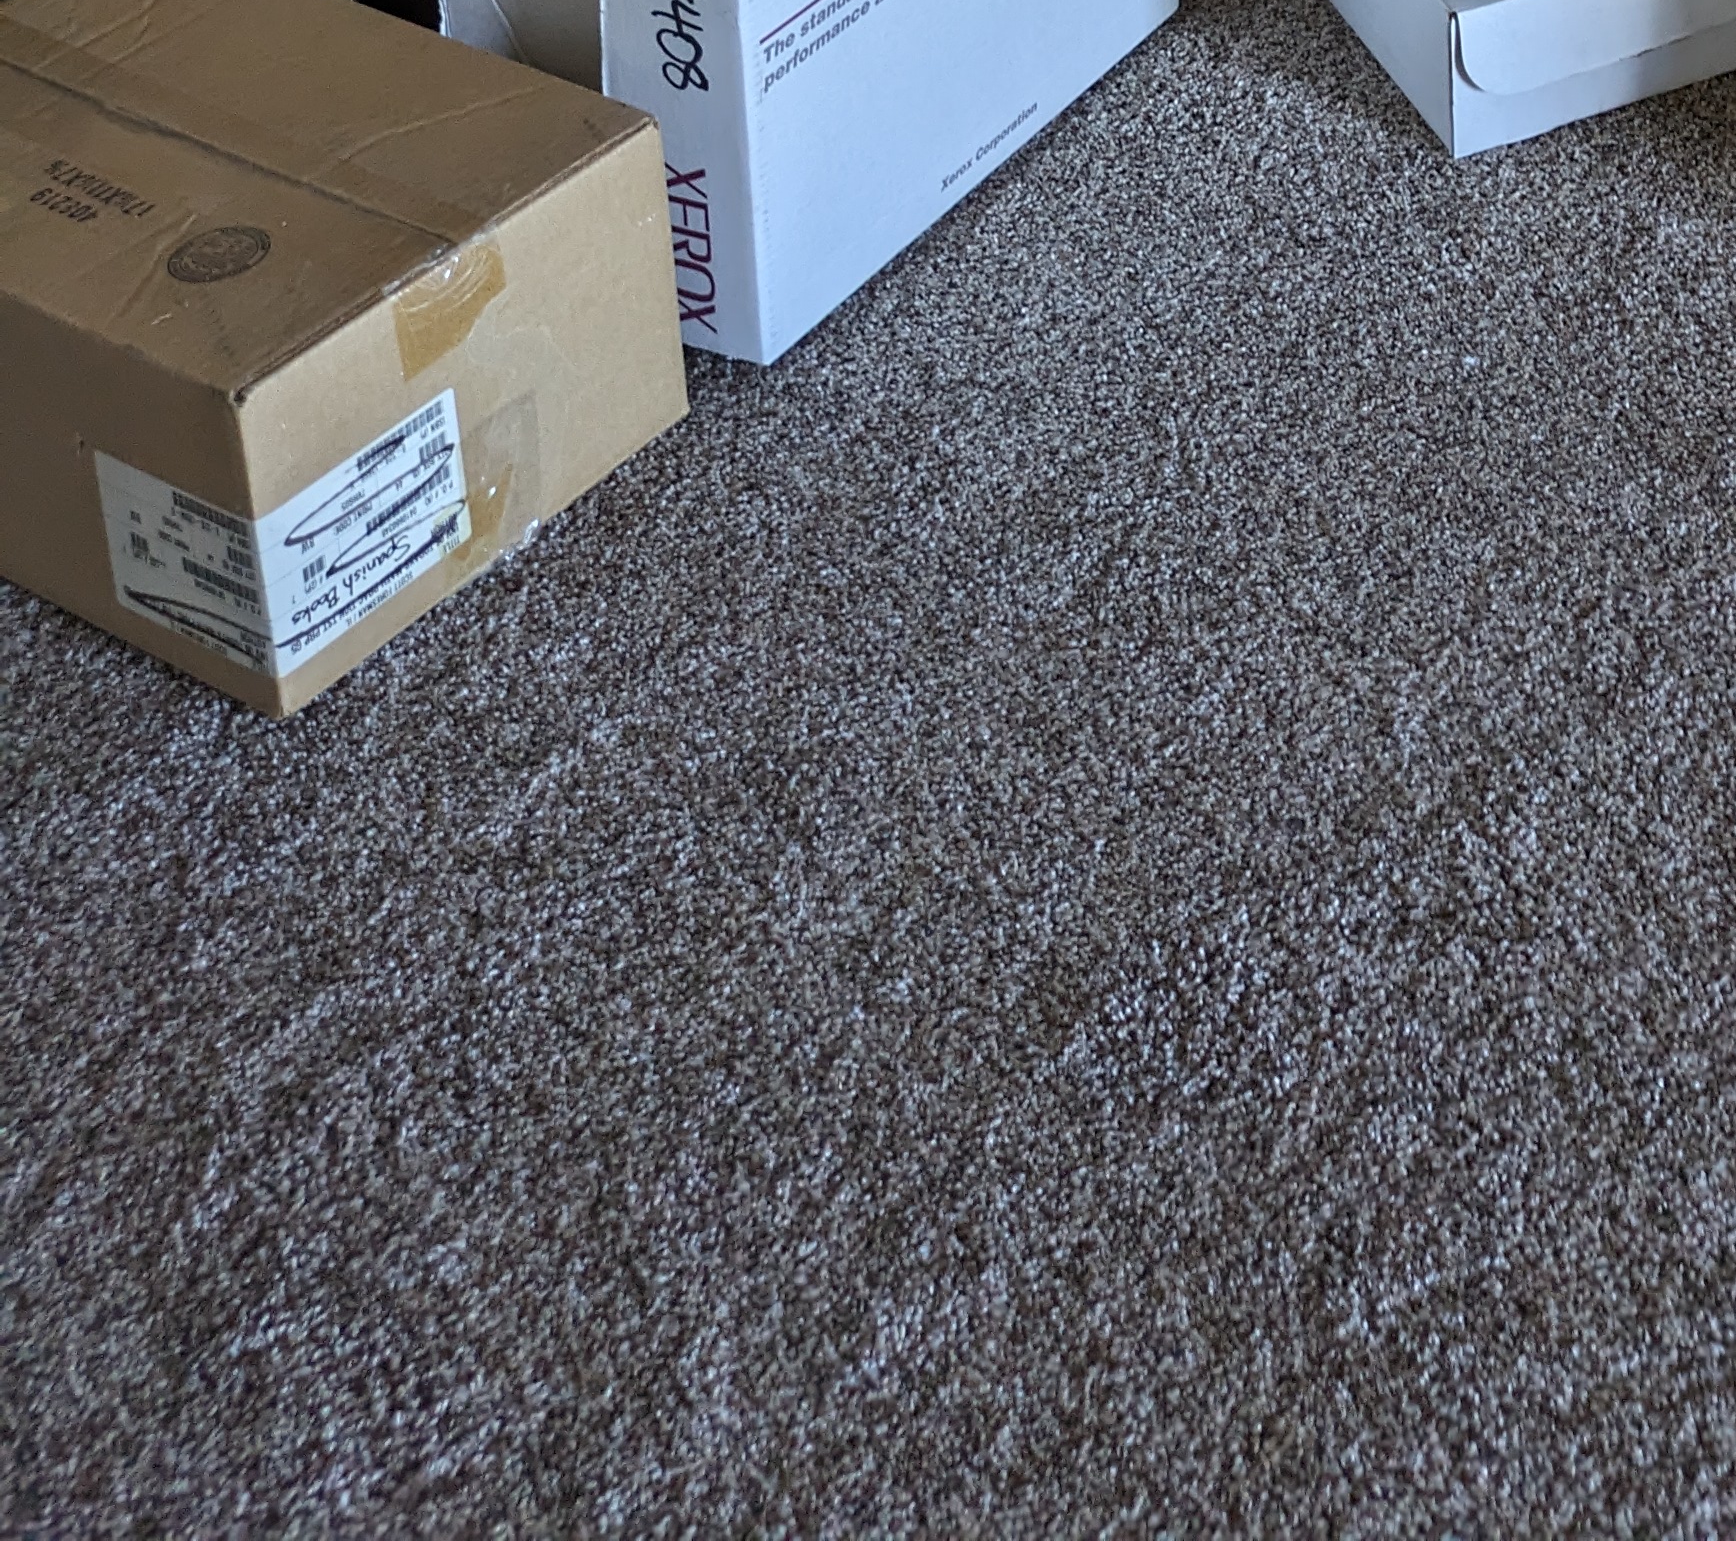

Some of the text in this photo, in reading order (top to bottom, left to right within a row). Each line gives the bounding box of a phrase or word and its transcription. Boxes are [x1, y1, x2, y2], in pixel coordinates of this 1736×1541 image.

[762, 31, 796, 64] The
[940, 101, 1039, 194] Xerox Corporation
[664, 161, 719, 335] XEROX
[291, 533, 412, 625] Spanish Books
